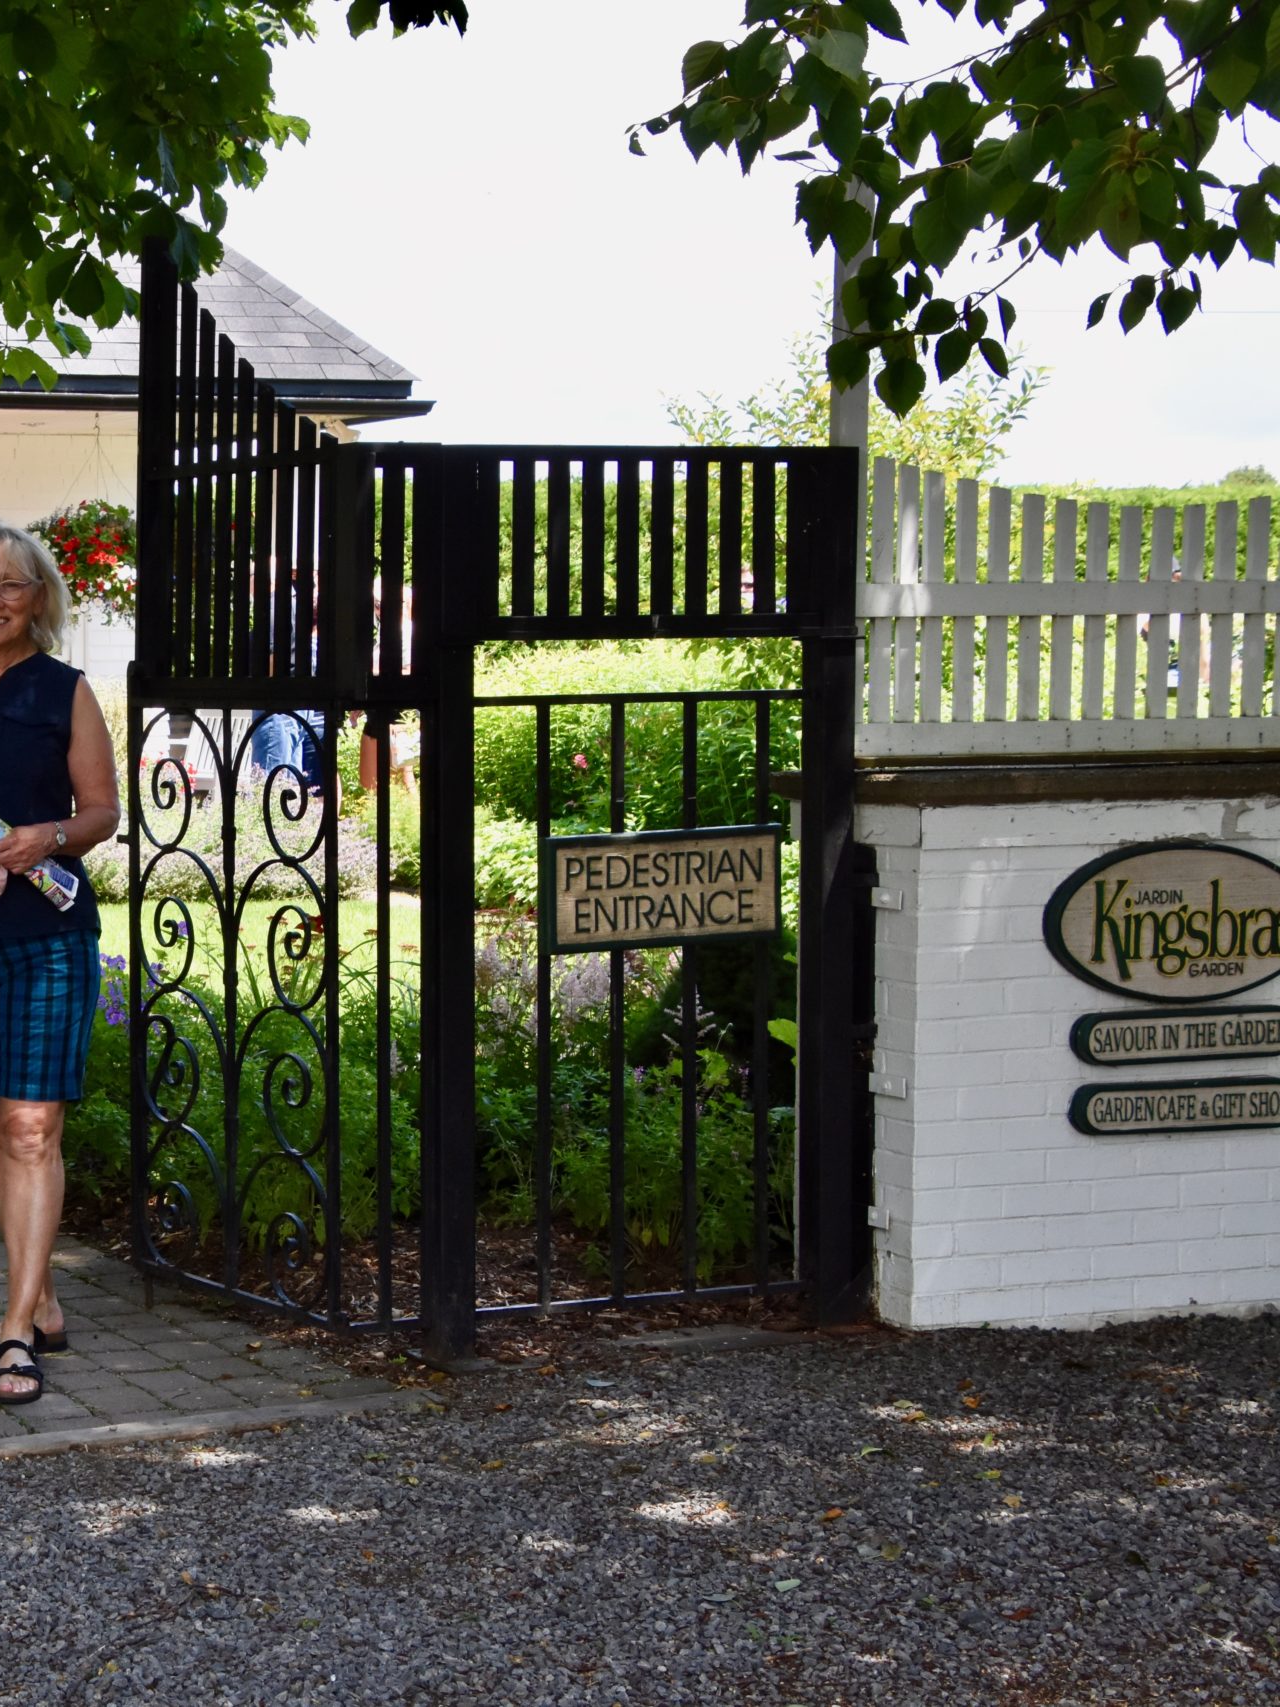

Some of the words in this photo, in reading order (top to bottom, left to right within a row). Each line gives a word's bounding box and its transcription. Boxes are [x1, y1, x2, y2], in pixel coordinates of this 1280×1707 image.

[564, 848, 763, 891] PEDESTRIAN
[575, 889, 754, 934] ENTRANCE
[1135, 890, 1183, 905] JARDIN
[1189, 962, 1244, 978] GARDEN
[1093, 1025, 1157, 1053] SAVOUR
[1162, 1024, 1180, 1049] IN
[1184, 1022, 1217, 1048] THE
[1222, 1019, 1280, 1046] GARDE
[1094, 1097, 1155, 1123] GARDEN
[1157, 1095, 1196, 1120] CAFE
[1200, 1101, 1209, 1116] &
[1212, 1093, 1246, 1118] GIFT
